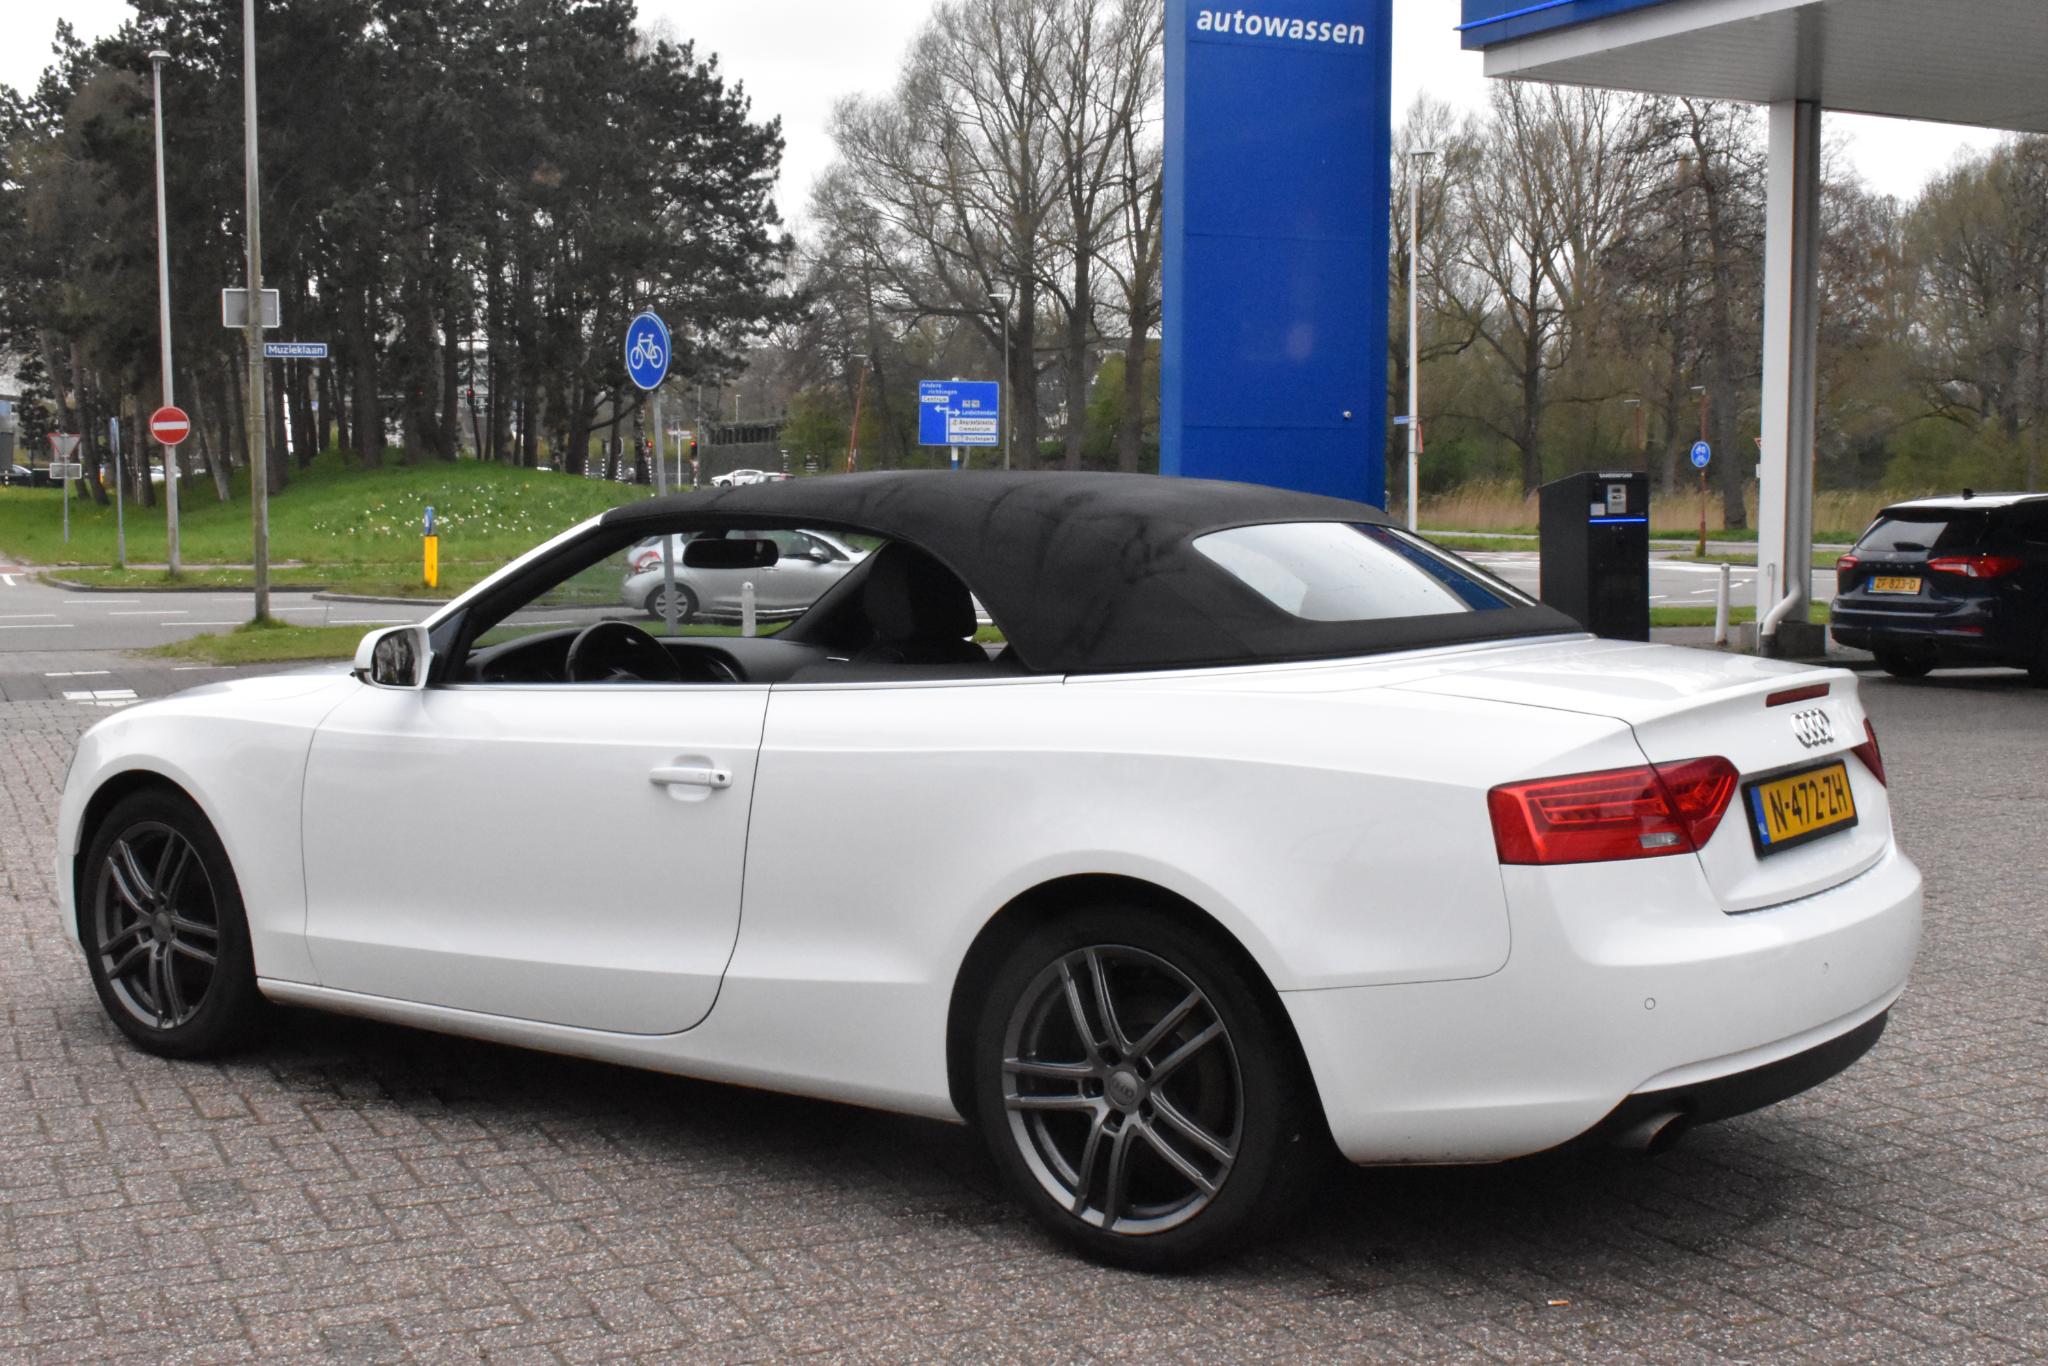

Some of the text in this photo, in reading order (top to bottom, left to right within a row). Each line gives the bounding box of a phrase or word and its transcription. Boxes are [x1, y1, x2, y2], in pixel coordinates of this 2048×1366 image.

[1196, 9, 1366, 45] autowassen
[268, 345, 323, 355] Muzieklaan
[1768, 773, 1848, 834] N-472-ZH
